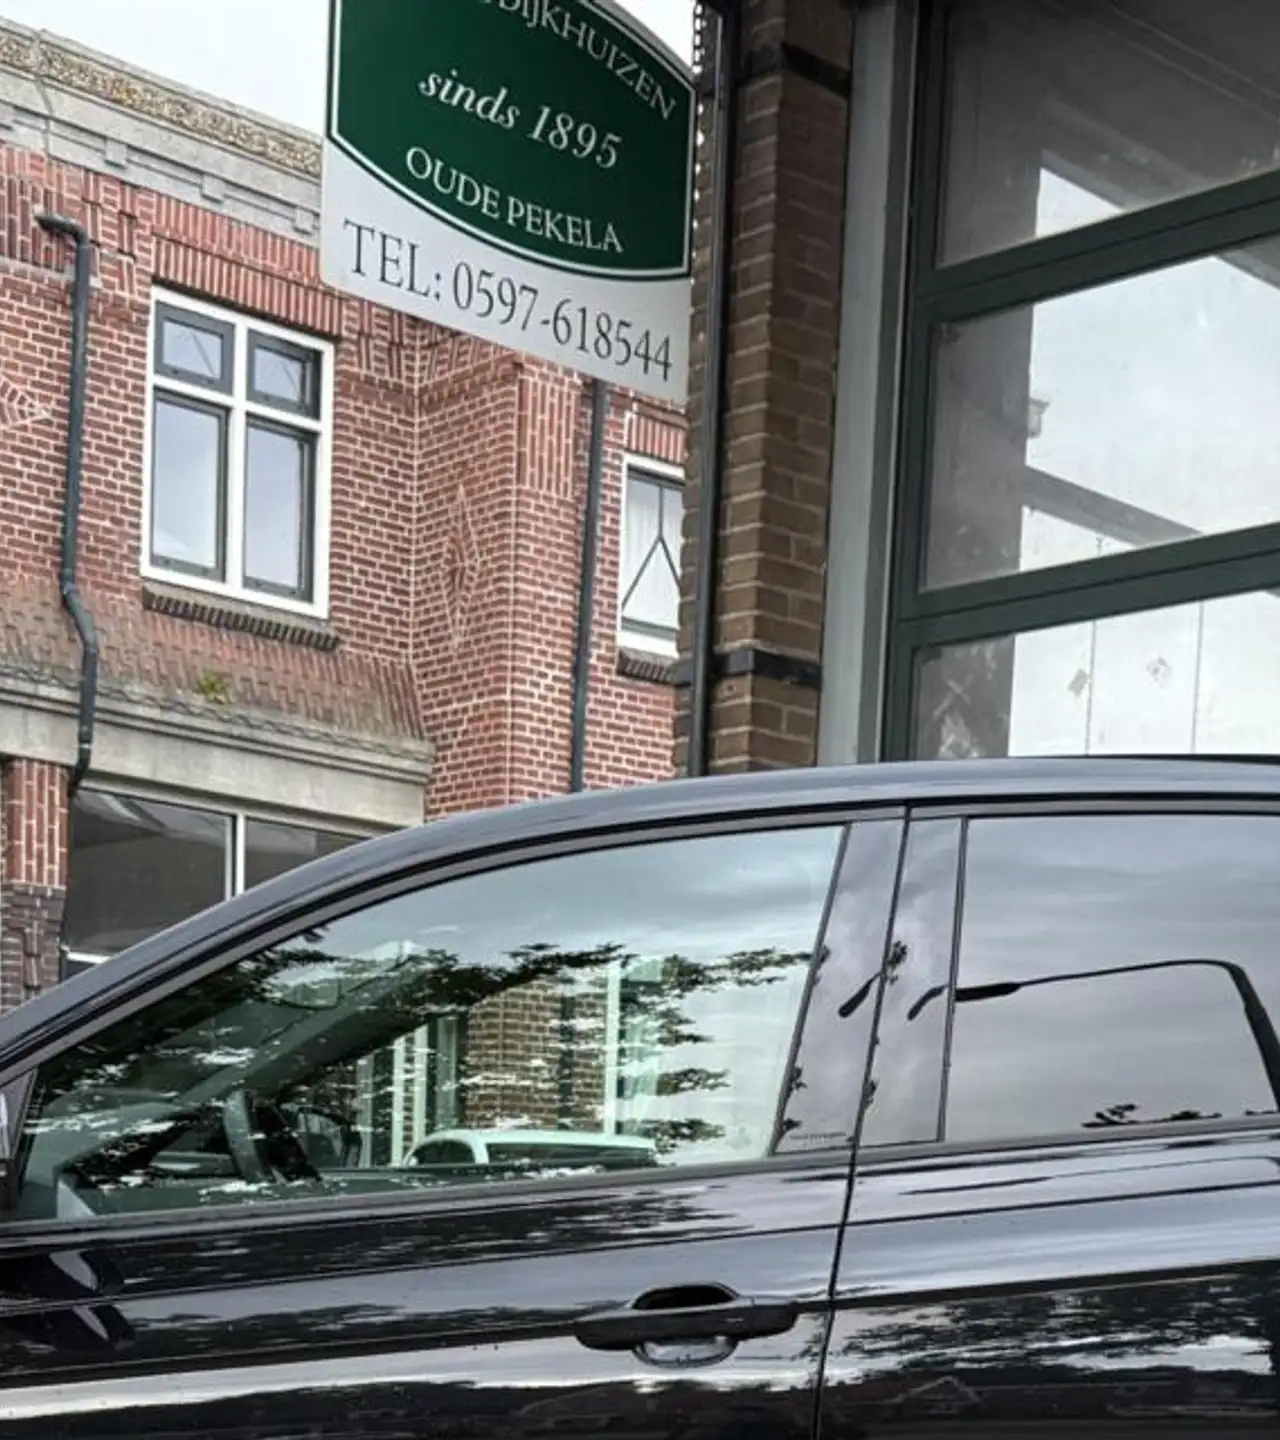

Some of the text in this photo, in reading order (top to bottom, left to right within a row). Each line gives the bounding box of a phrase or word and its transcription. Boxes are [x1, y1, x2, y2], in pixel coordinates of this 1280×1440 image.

[419, 69, 622, 169] sinds 1895
[405, 146, 624, 253] OUDE PEKELA
[343, 219, 673, 381] TEL: 0597-618544
